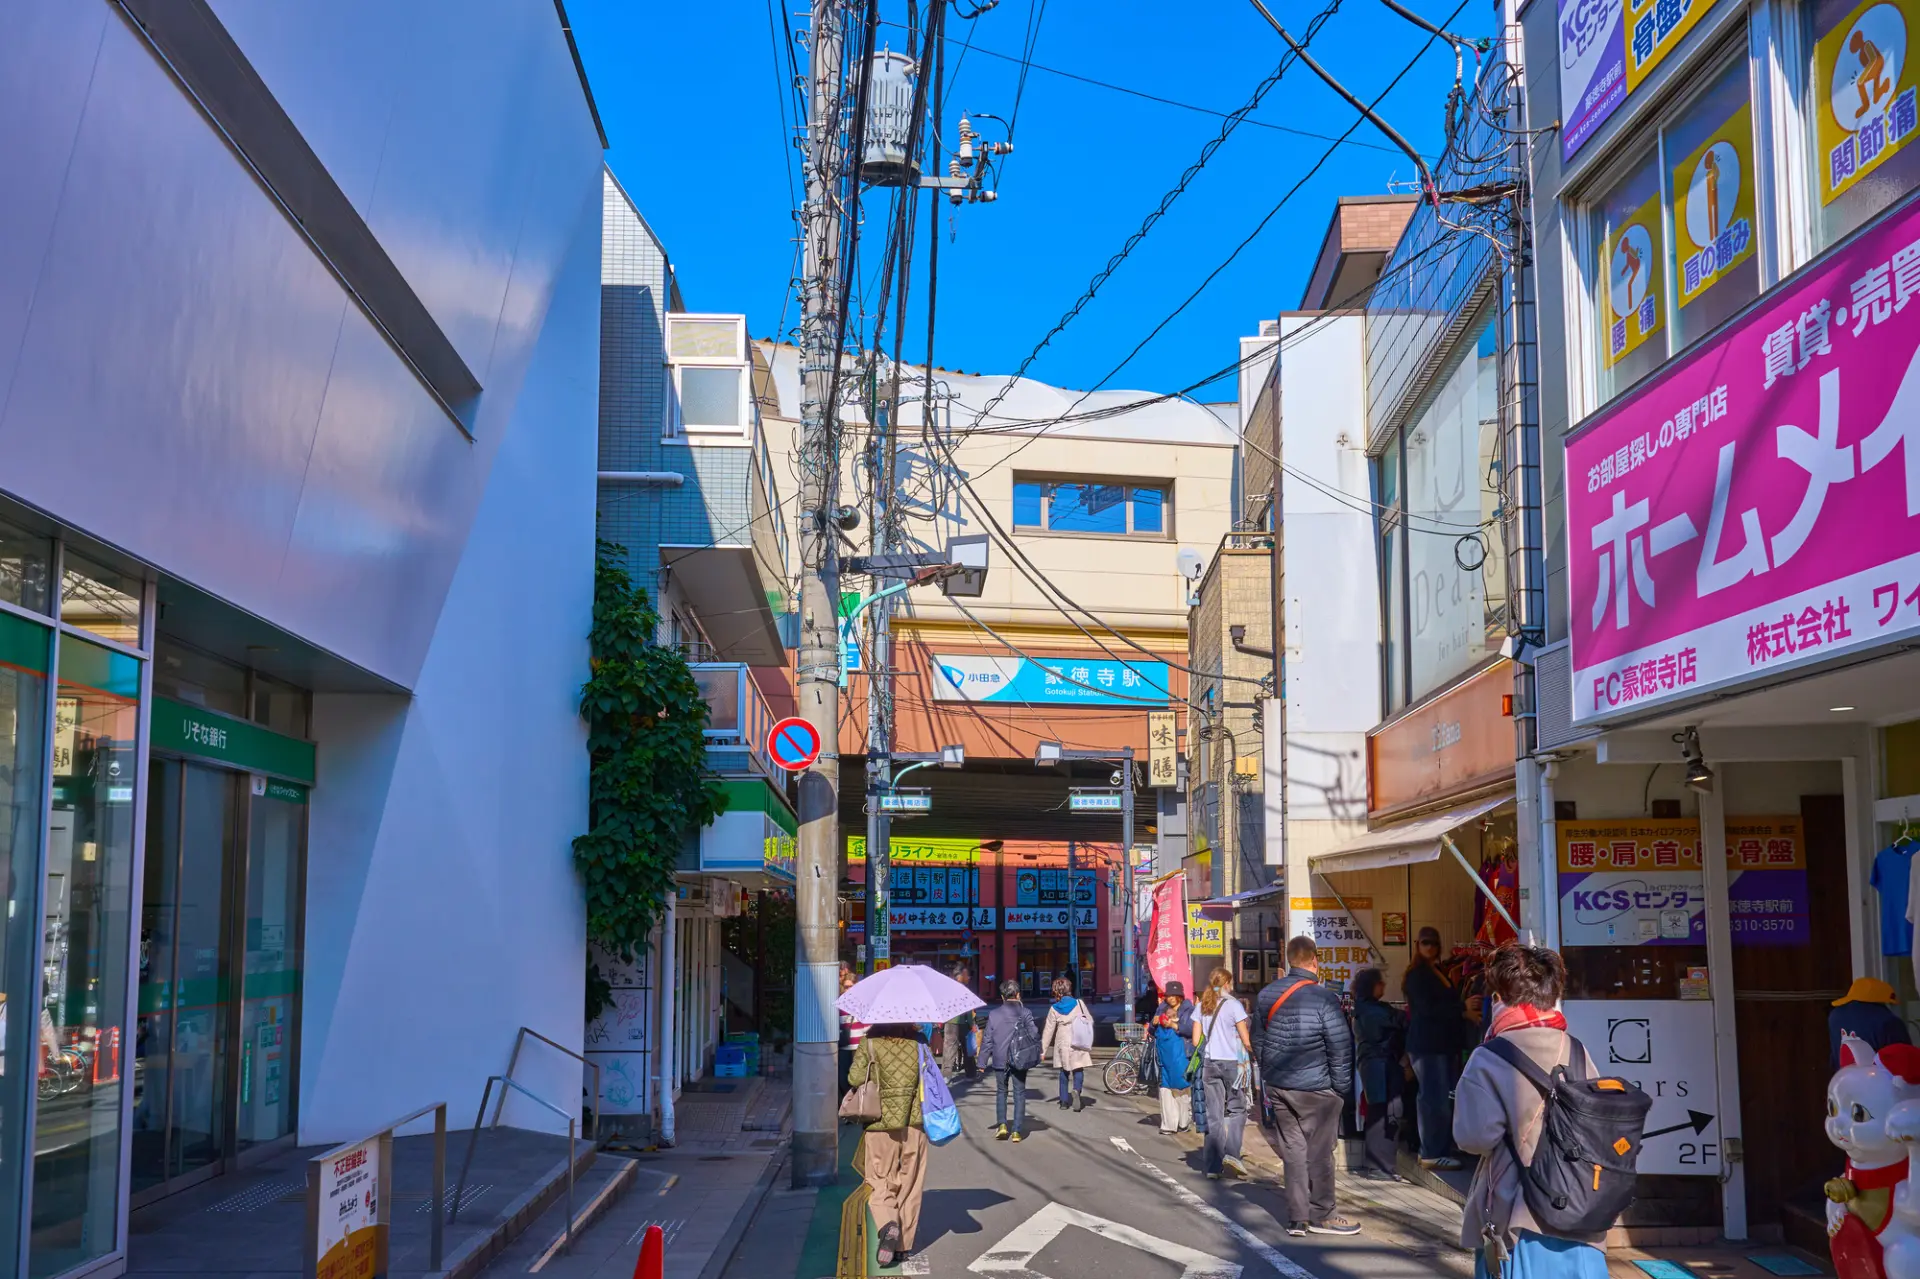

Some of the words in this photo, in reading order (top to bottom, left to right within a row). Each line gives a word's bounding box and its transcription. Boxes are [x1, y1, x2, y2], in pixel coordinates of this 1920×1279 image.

[1630, 0, 1692, 67] 骨盤
[1830, 85, 1917, 189] 関節痛
[1683, 218, 1749, 294] 肩の痛み
[1587, 384, 1727, 492] お部屋探しの専門店
[1746, 596, 1850, 664] 株式会社
[968, 673, 1000, 683] 小田急
[1044, 666, 1141, 687] 豪徳寺駅
[1593, 647, 1697, 710] FC豪徳寺店
[1045, 688, 1076, 697] Gotokuji
[183, 719, 227, 749] りそな銀行
[1570, 838, 1795, 867] 腰・肩・首・・骨盤
[1573, 891, 1631, 911] KCS
[1190, 927, 1220, 942] 料理
[1317, 947, 1369, 964] 頭買取
[1679, 1143, 1717, 1164] 2F
